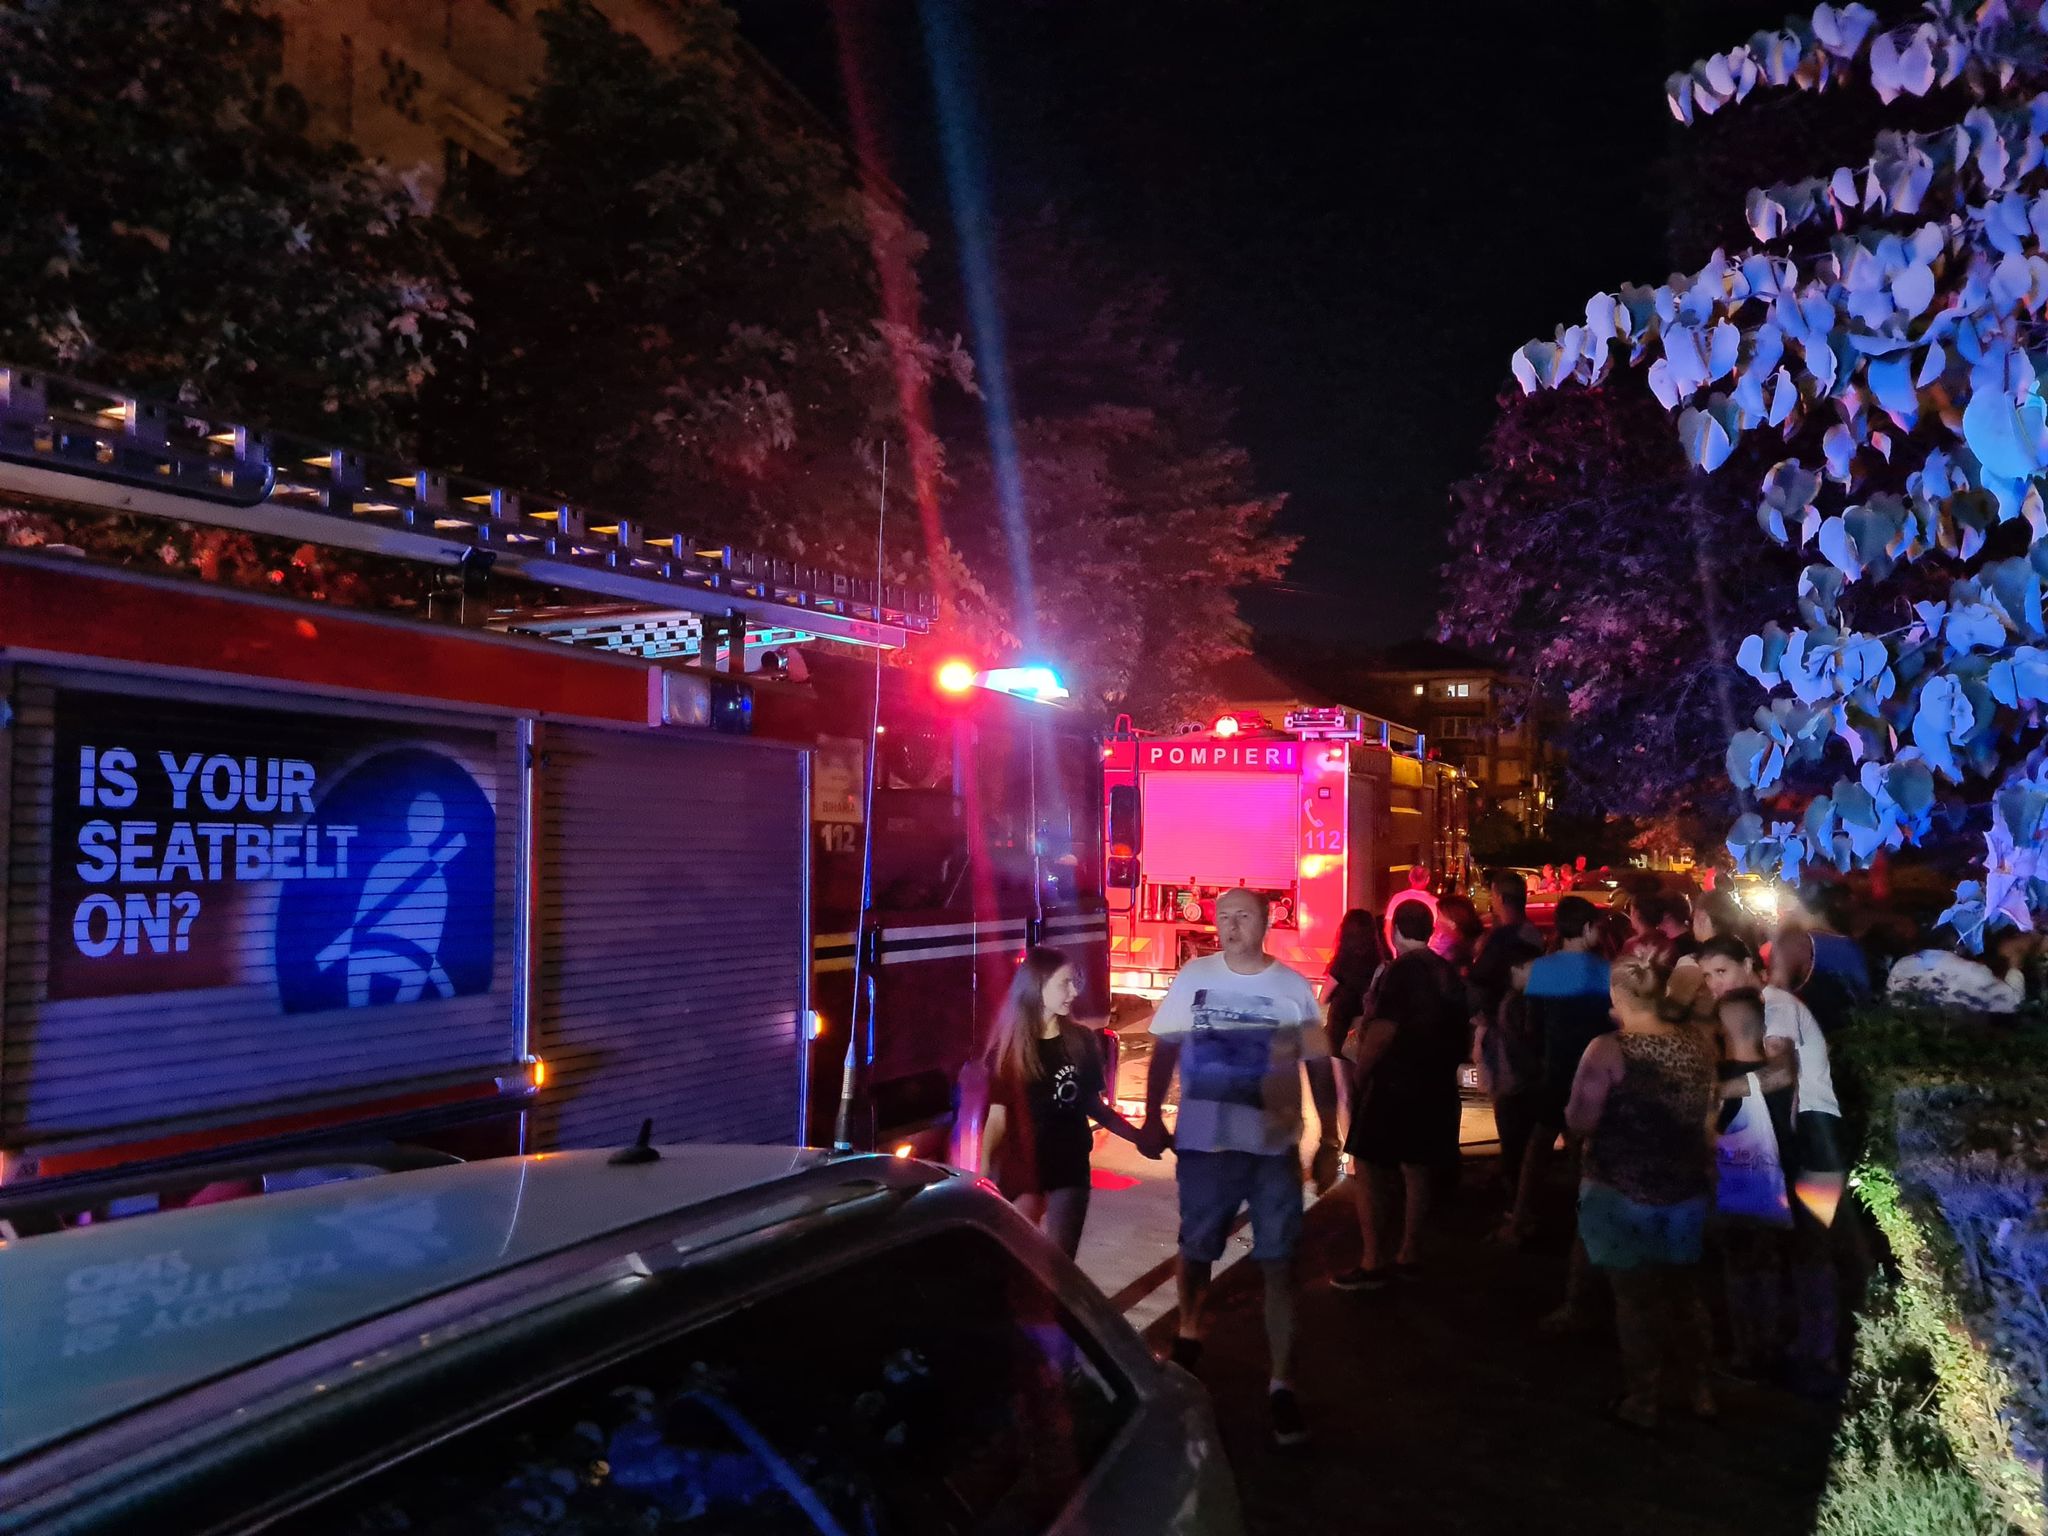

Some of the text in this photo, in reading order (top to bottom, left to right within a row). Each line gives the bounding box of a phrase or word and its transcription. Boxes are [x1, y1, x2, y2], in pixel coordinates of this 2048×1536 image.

[79, 745, 316, 813] IS YOUR
[1150, 747, 1293, 765] POMPIERI
[76, 820, 358, 883] SEATBELT
[821, 823, 855, 852] 112
[1304, 830, 1341, 850] 112
[73, 891, 200, 958] ON?
